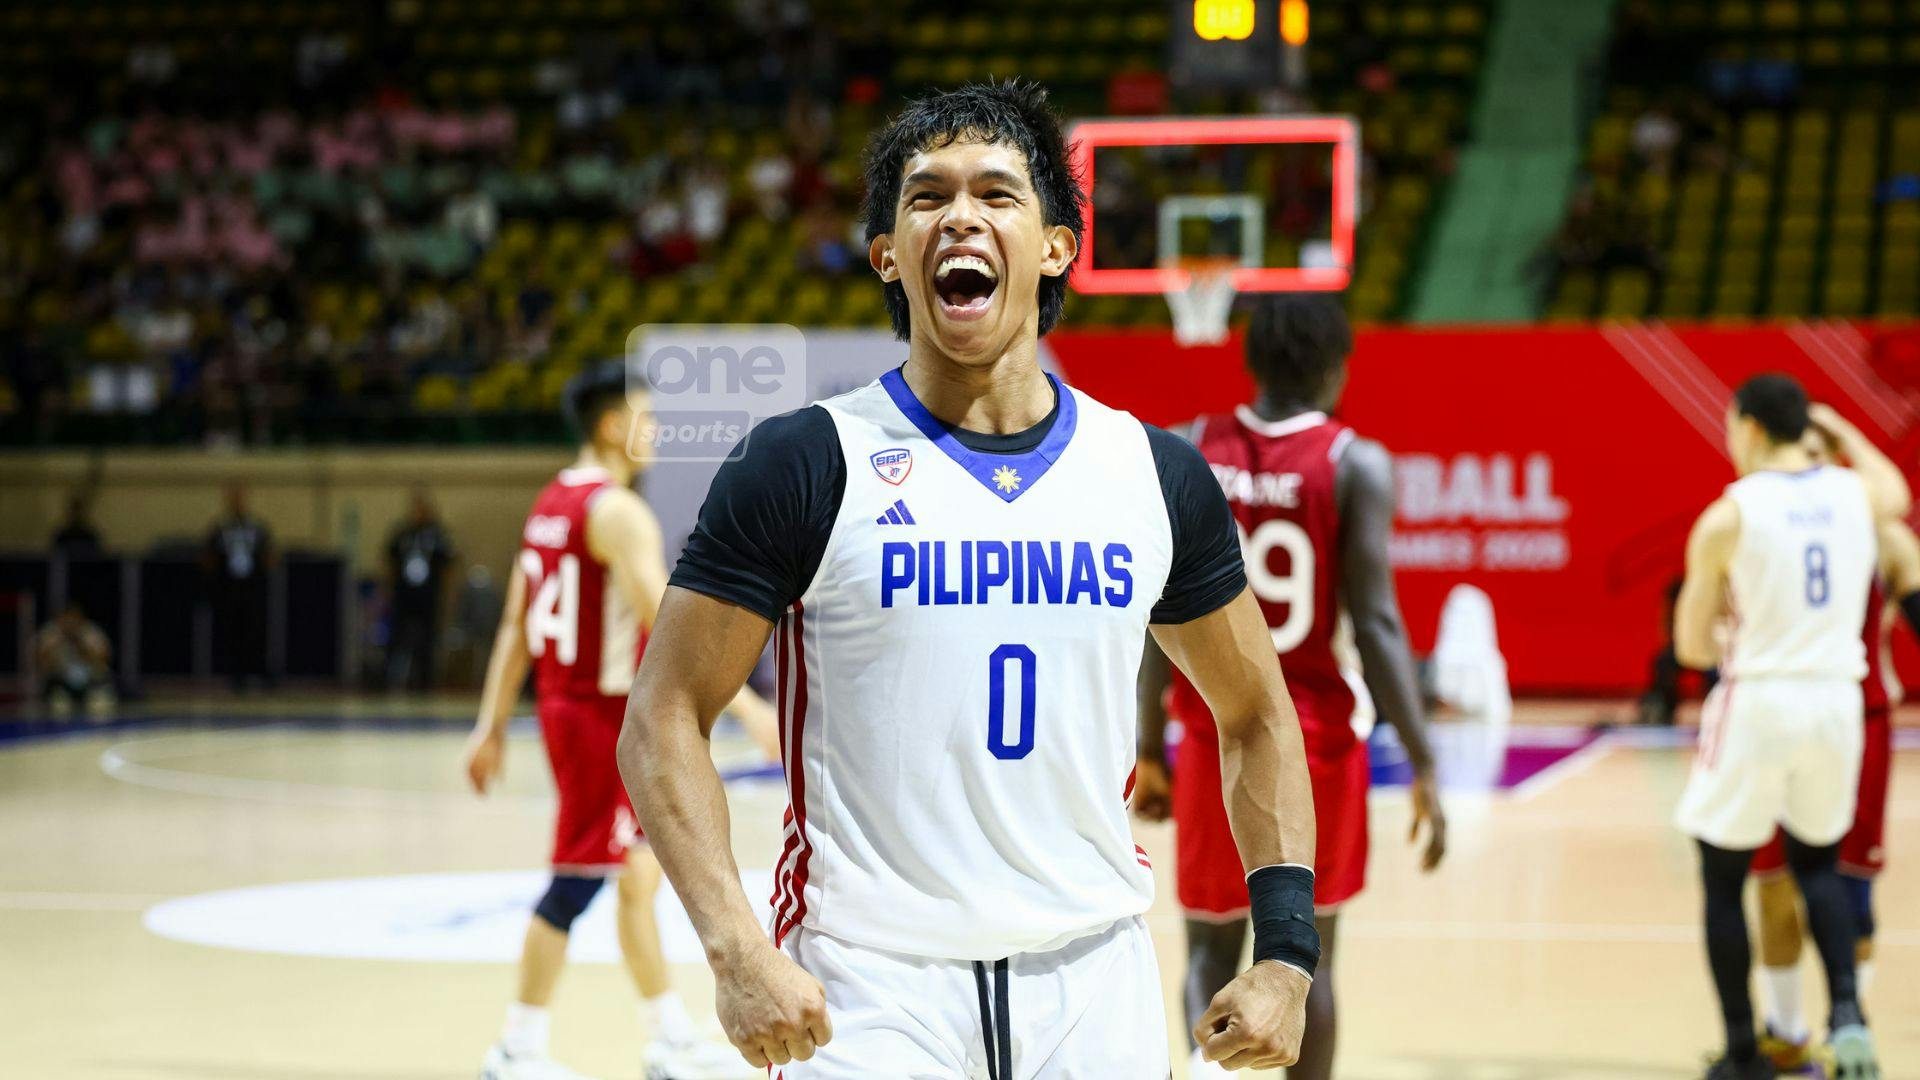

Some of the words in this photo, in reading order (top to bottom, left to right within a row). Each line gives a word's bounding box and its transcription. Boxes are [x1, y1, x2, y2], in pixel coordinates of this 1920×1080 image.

[1393, 453, 1571, 522] BALL
[881, 541, 1133, 608] PILIPINAS
[1238, 518, 1315, 654] 9
[1804, 544, 1829, 607] 8
[987, 643, 1036, 760] 0
